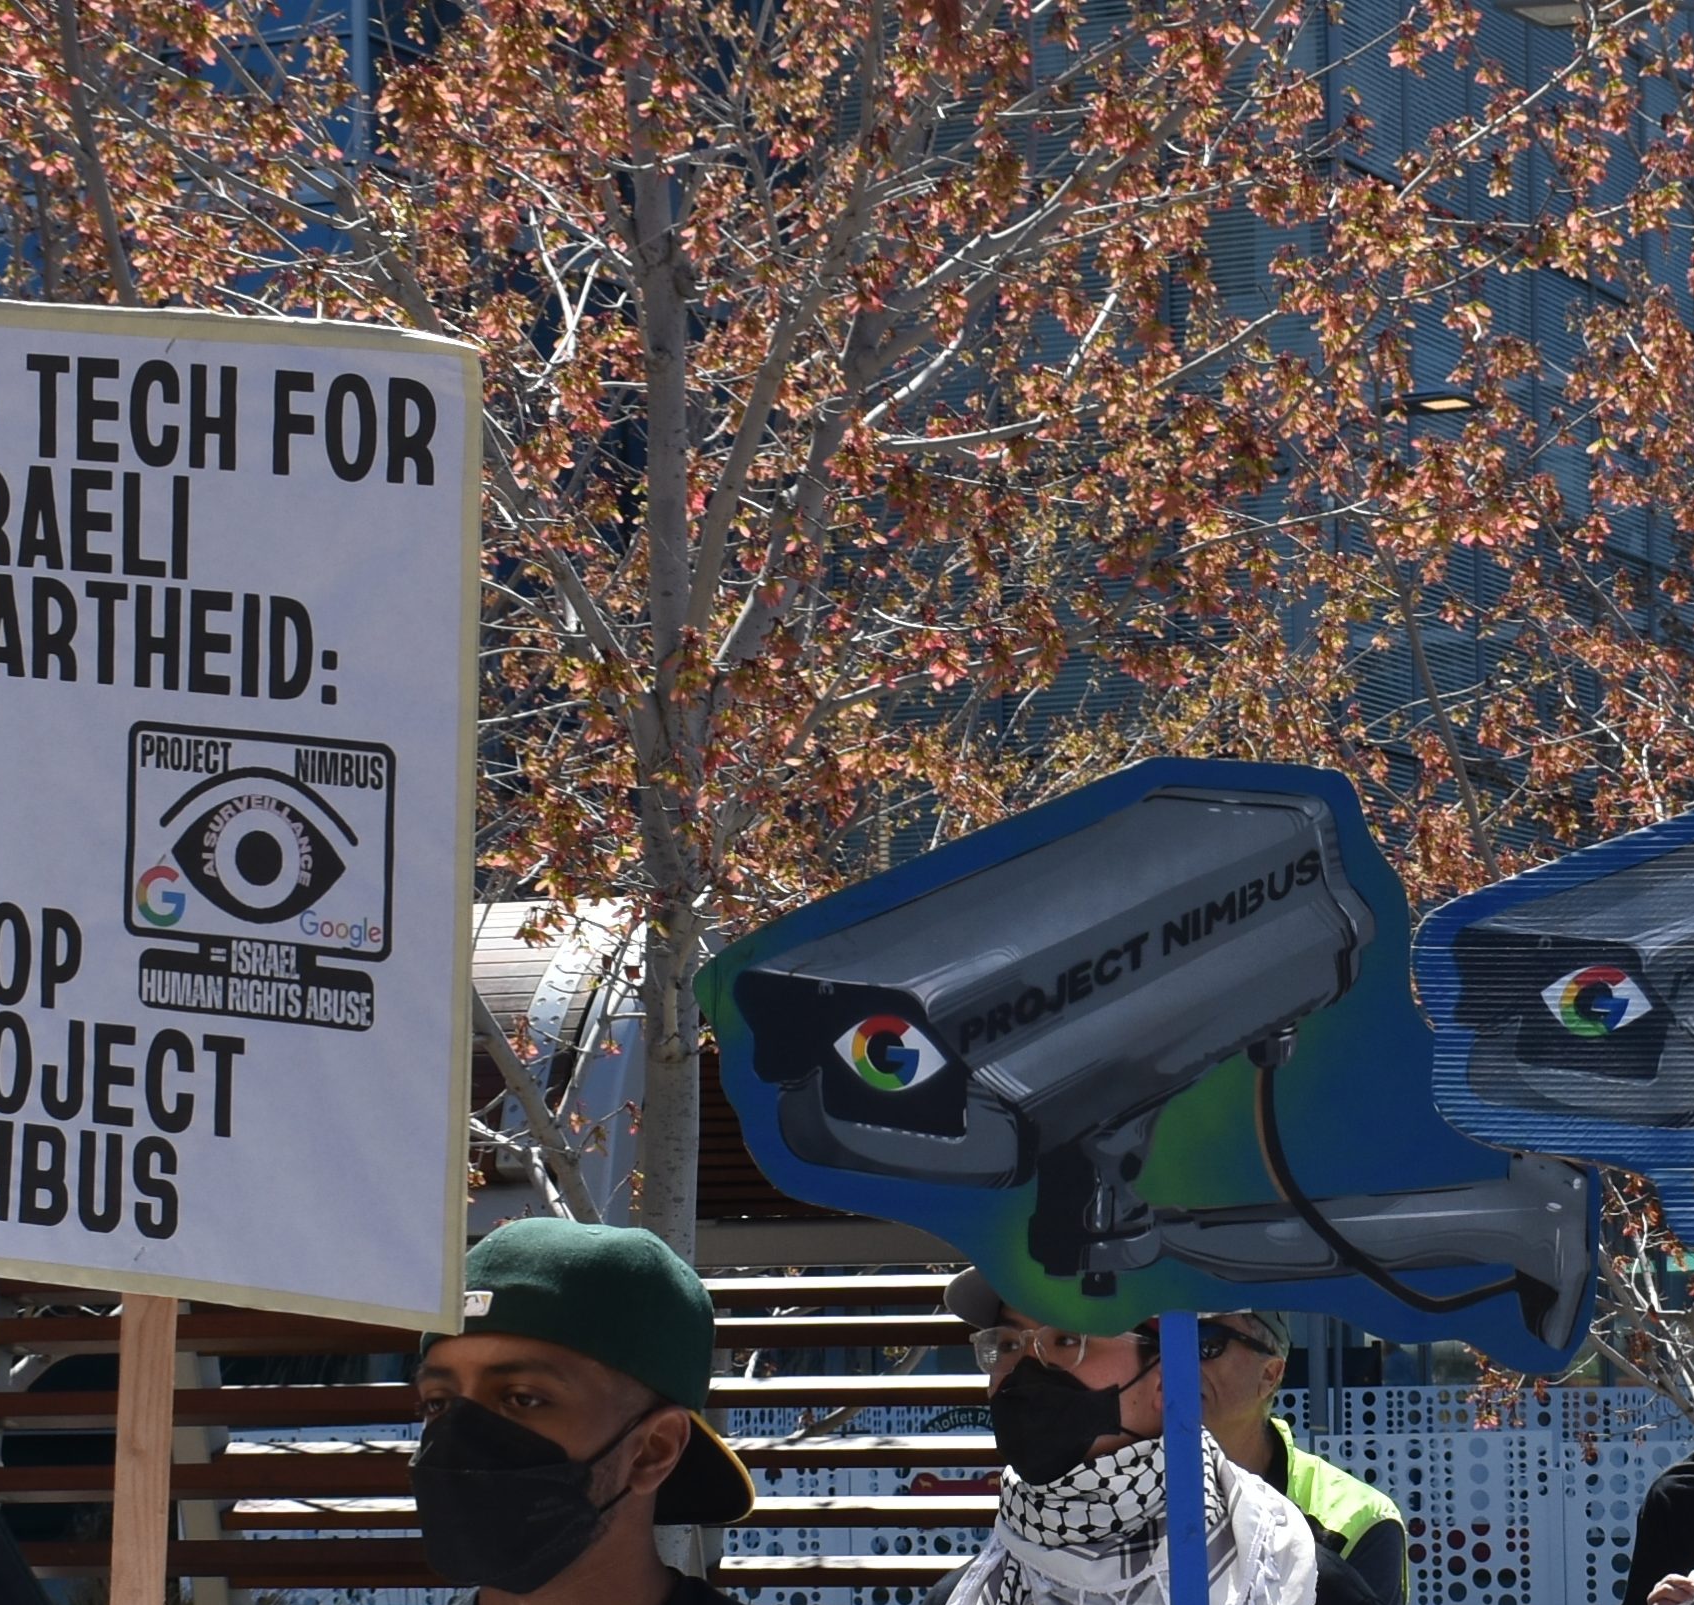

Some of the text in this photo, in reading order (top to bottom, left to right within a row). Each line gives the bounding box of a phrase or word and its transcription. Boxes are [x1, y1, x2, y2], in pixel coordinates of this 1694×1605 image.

[26, 353, 238, 471] TECH
[271, 369, 437, 486] FOR
[140, 733, 384, 791] PROJECT NIMBUS
[203, 794, 314, 888] SURVEILLANCE
[135, 865, 186, 927] G
[299, 909, 382, 948] Google
[958, 848, 1321, 1055] PROJECT NIMBUS
[230, 939, 301, 980] ISRAEL
[141, 967, 372, 1027] HUMAN RIGHTS ABUSE
[927, 1409, 975, 1433] Moffet
